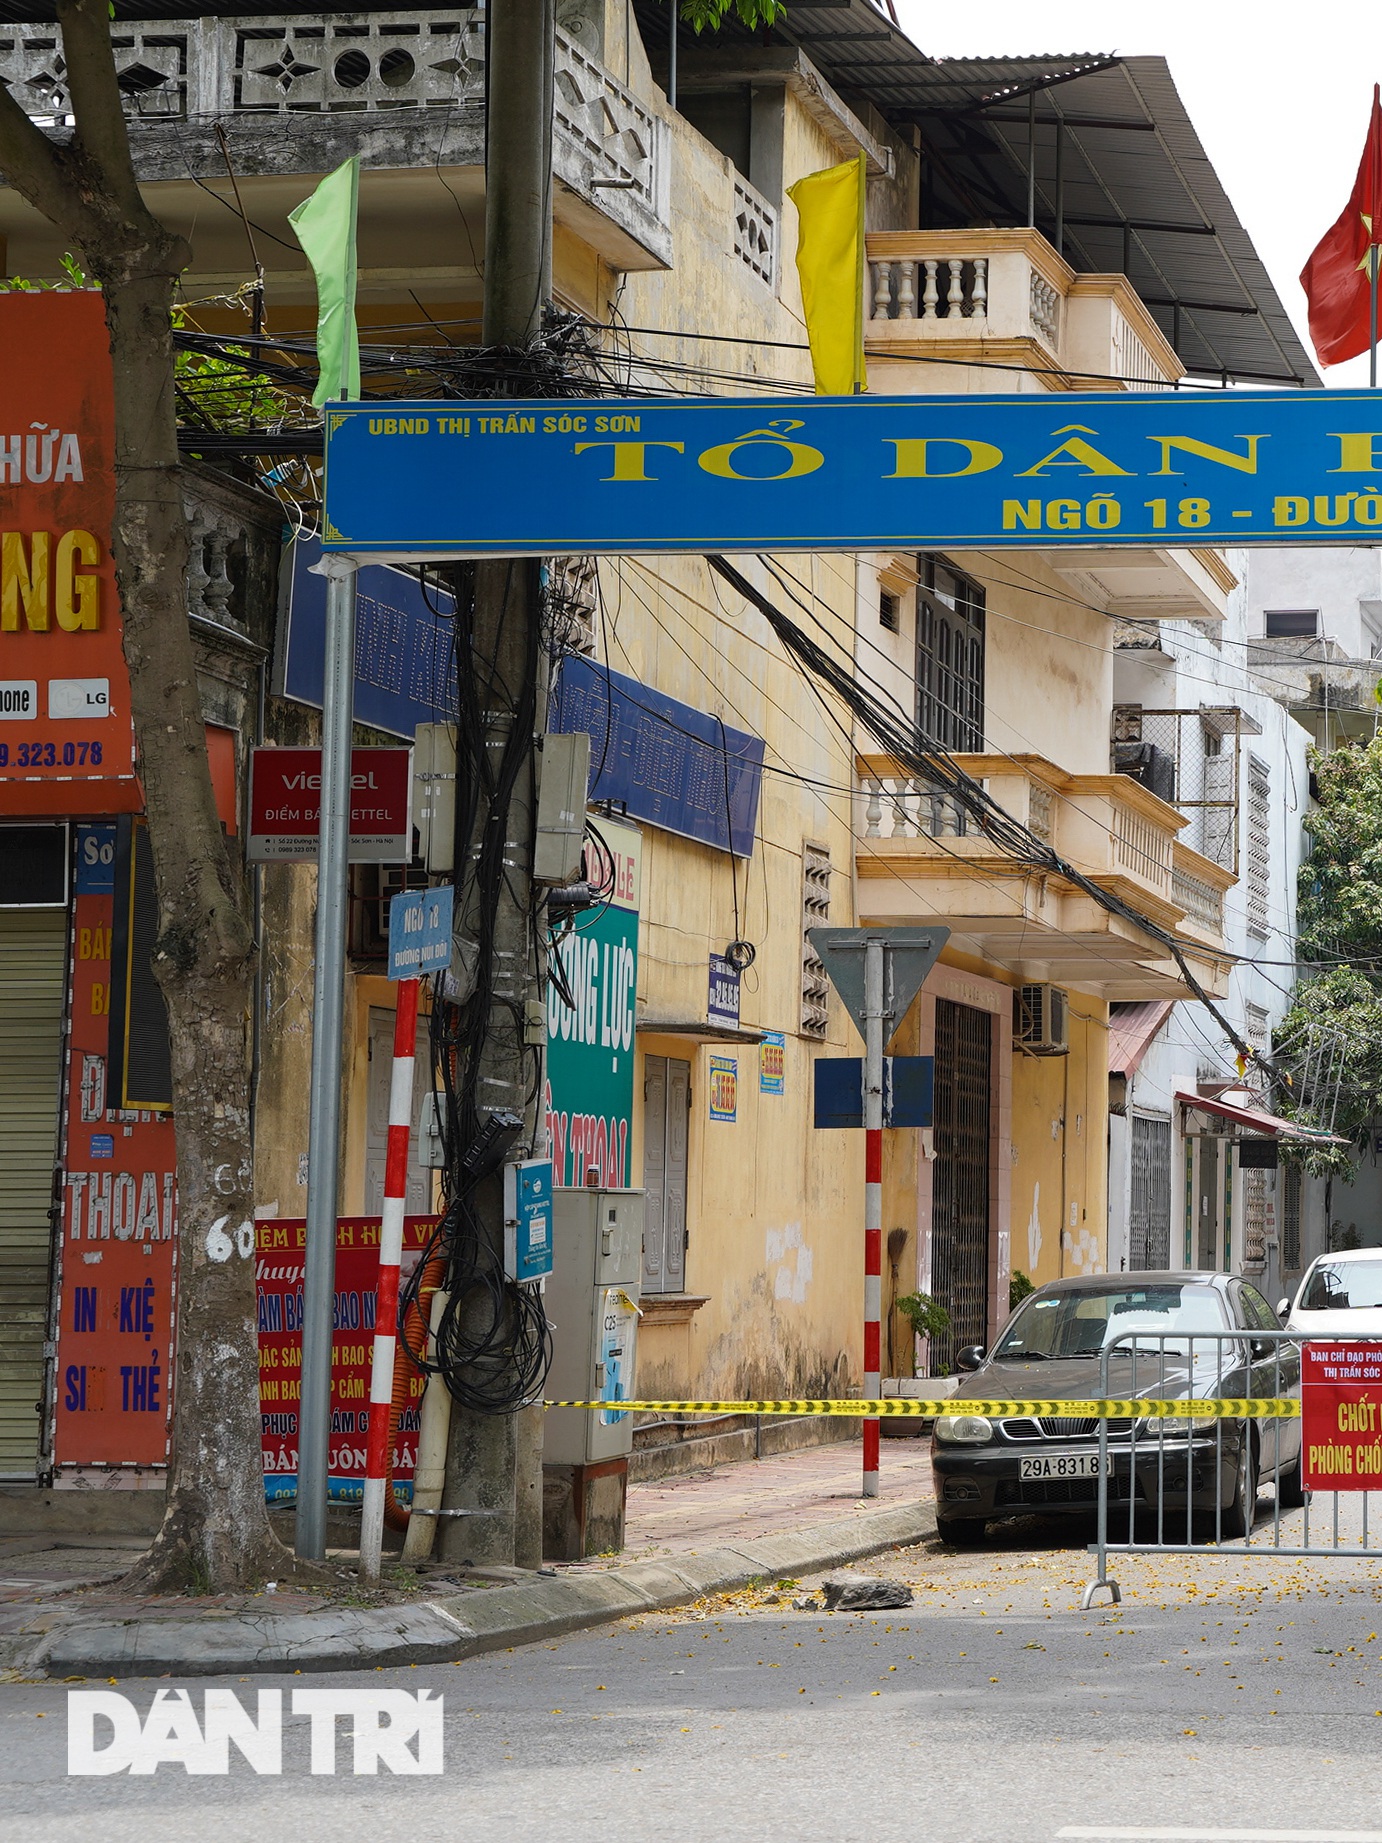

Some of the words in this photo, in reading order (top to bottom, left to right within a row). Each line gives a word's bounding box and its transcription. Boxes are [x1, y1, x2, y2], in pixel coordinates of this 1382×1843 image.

[369, 418, 429, 435] UBND
[437, 417, 470, 437] THỊ
[477, 411, 535, 434] TRẤN
[543, 413, 587, 433] SÓC
[594, 415, 641, 433] SƠN
[574, 419, 825, 481] TỔ
[881, 423, 1272, 479] DÂN
[1002, 492, 1122, 530] NGÕ
[1144, 498, 1211, 528] 18
[86, 692, 107, 705] LG
[265, 804, 300, 820] ĐIỂM
[342, 1345, 365, 1366] BAO
[1311, 1351, 1330, 1362] BAN
[1330, 1348, 1346, 1362] CHỈ
[1347, 1351, 1364, 1365] ĐẠO
[1323, 1367, 1337, 1380] THỊ
[1339, 1364, 1361, 1378] TRẤN
[1363, 1366, 1381, 1378] SÓC
[1337, 1393, 1376, 1432] CHỐT
[261, 1413, 297, 1439] PHỤC
[1309, 1438, 1353, 1475] PHÒNG
